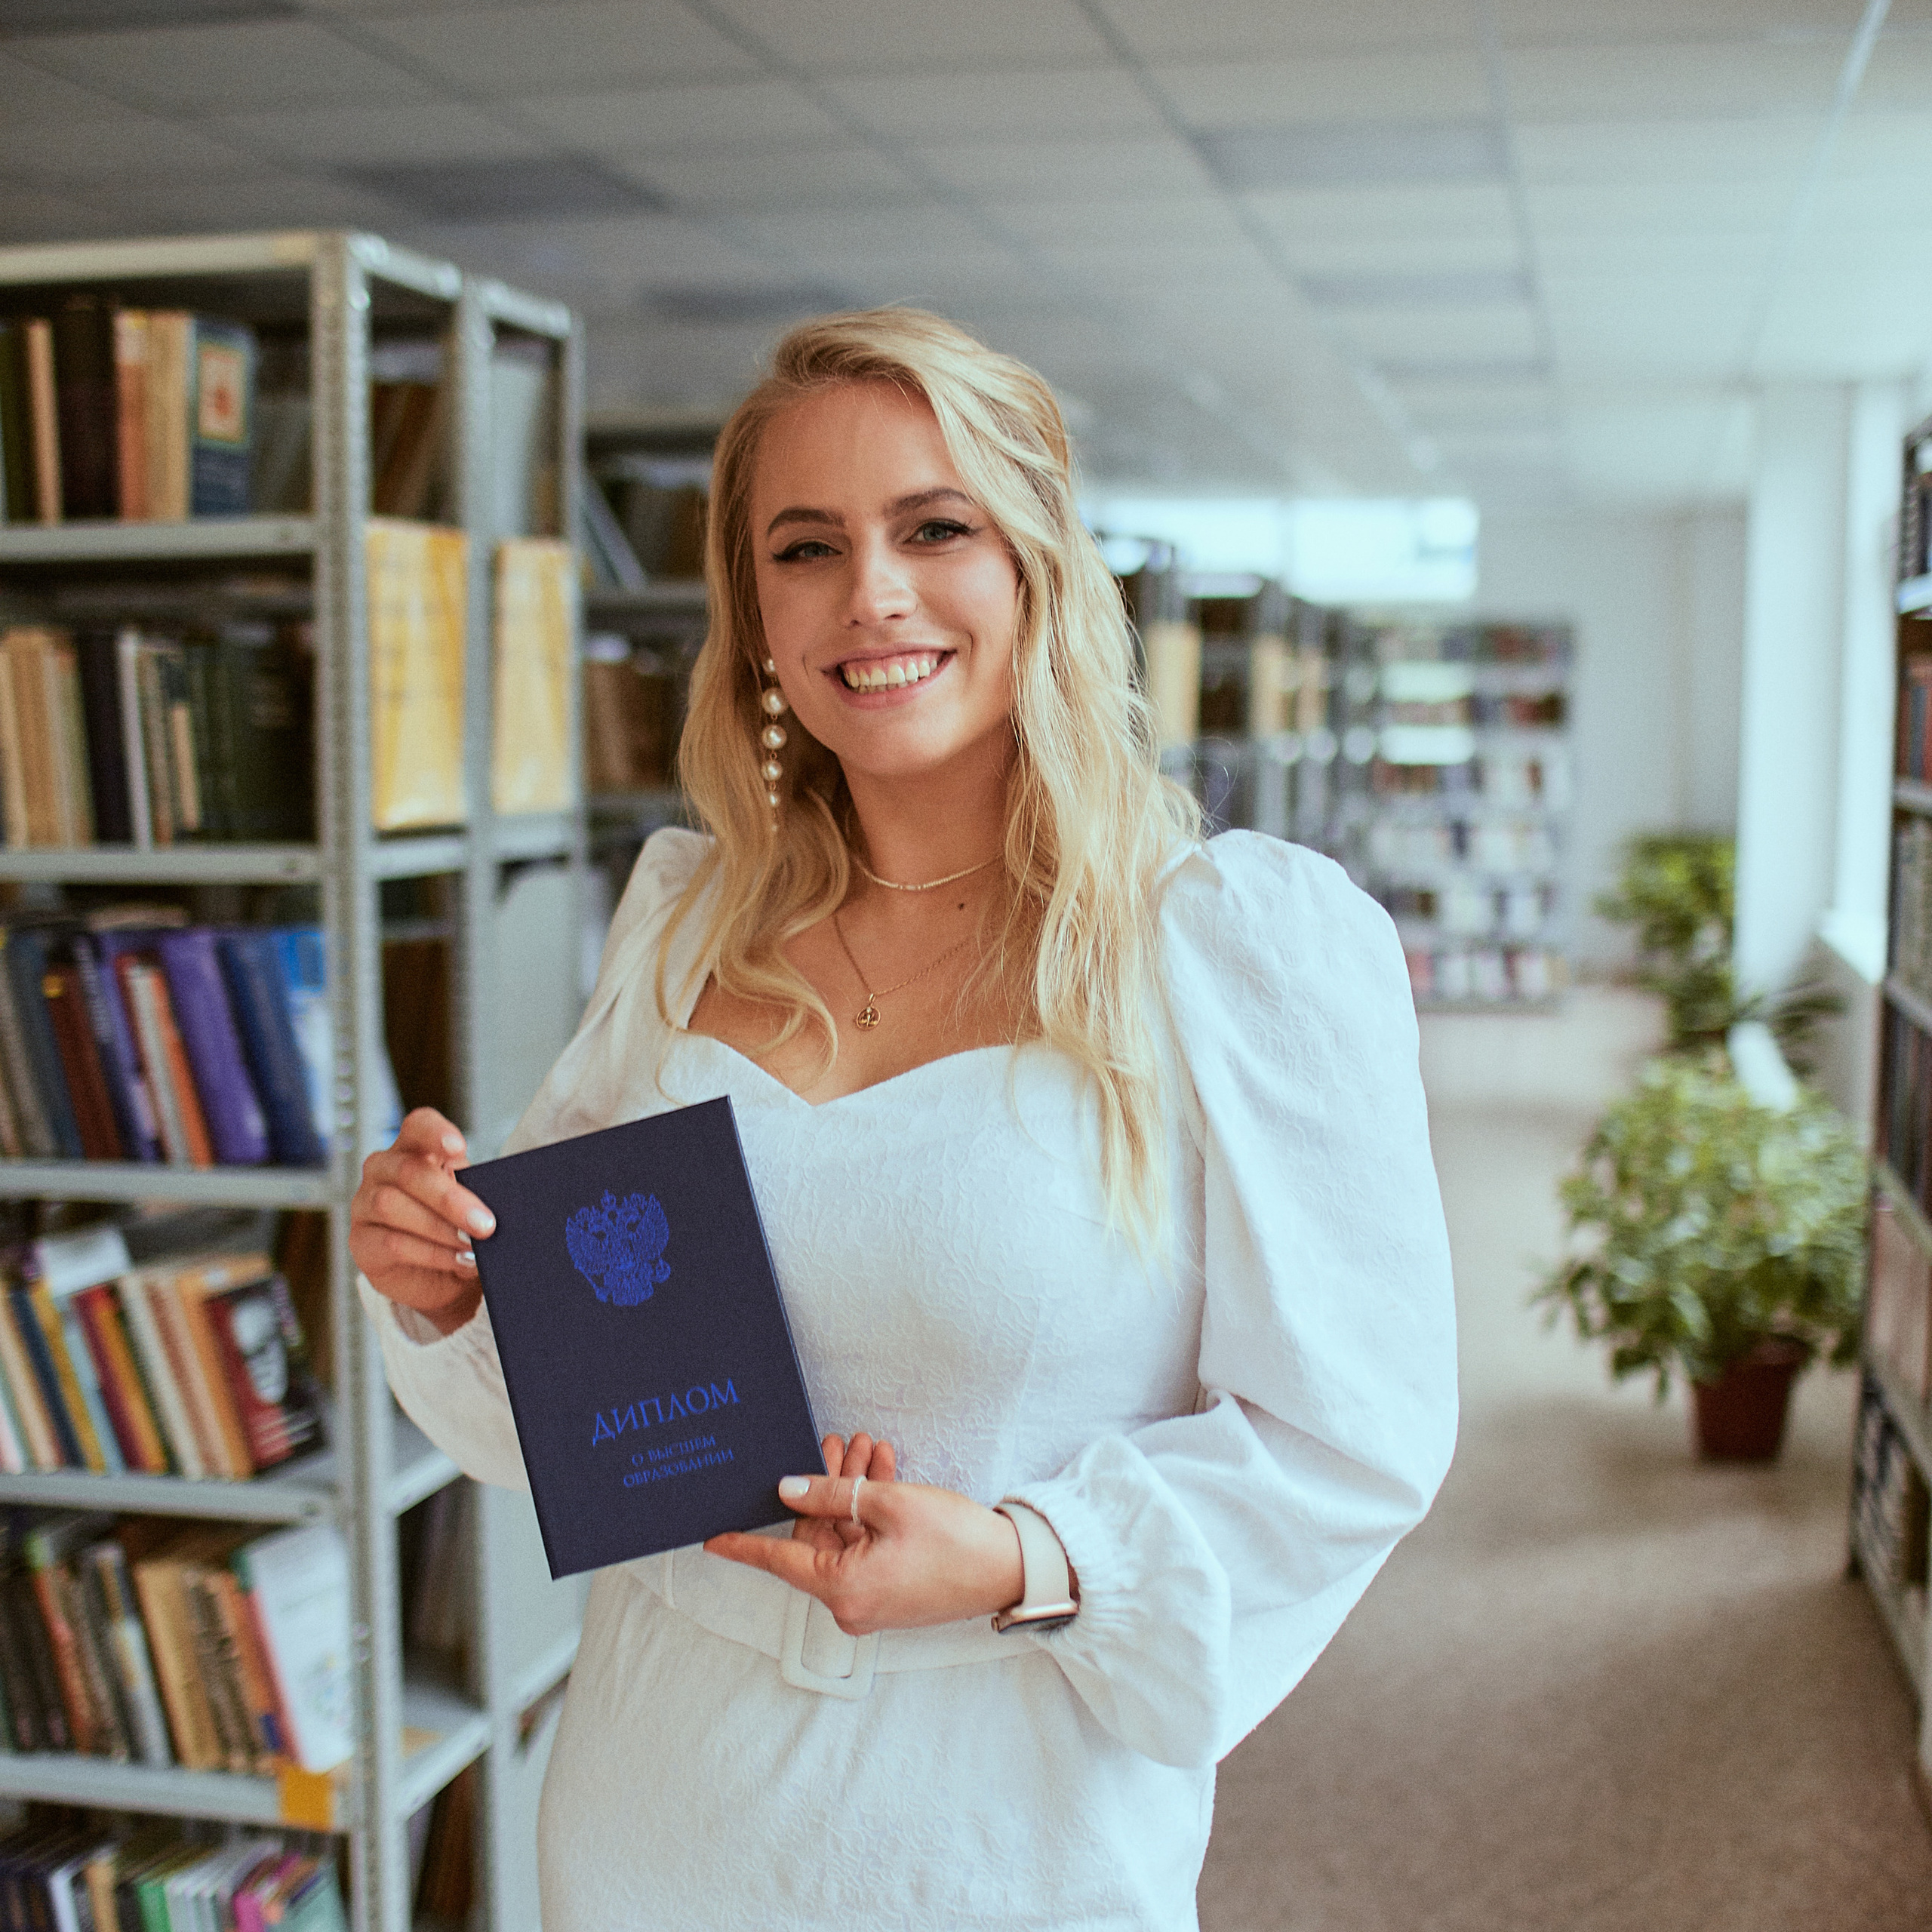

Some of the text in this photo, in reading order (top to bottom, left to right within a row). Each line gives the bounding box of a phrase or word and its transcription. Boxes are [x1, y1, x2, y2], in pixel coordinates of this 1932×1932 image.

[592, 1377, 741, 1447] ДИПЛОМ
[623, 1448, 735, 1488] ОБРАЗОВАНИИ
[632, 1435, 716, 1467] О ВЫСШЕМ
